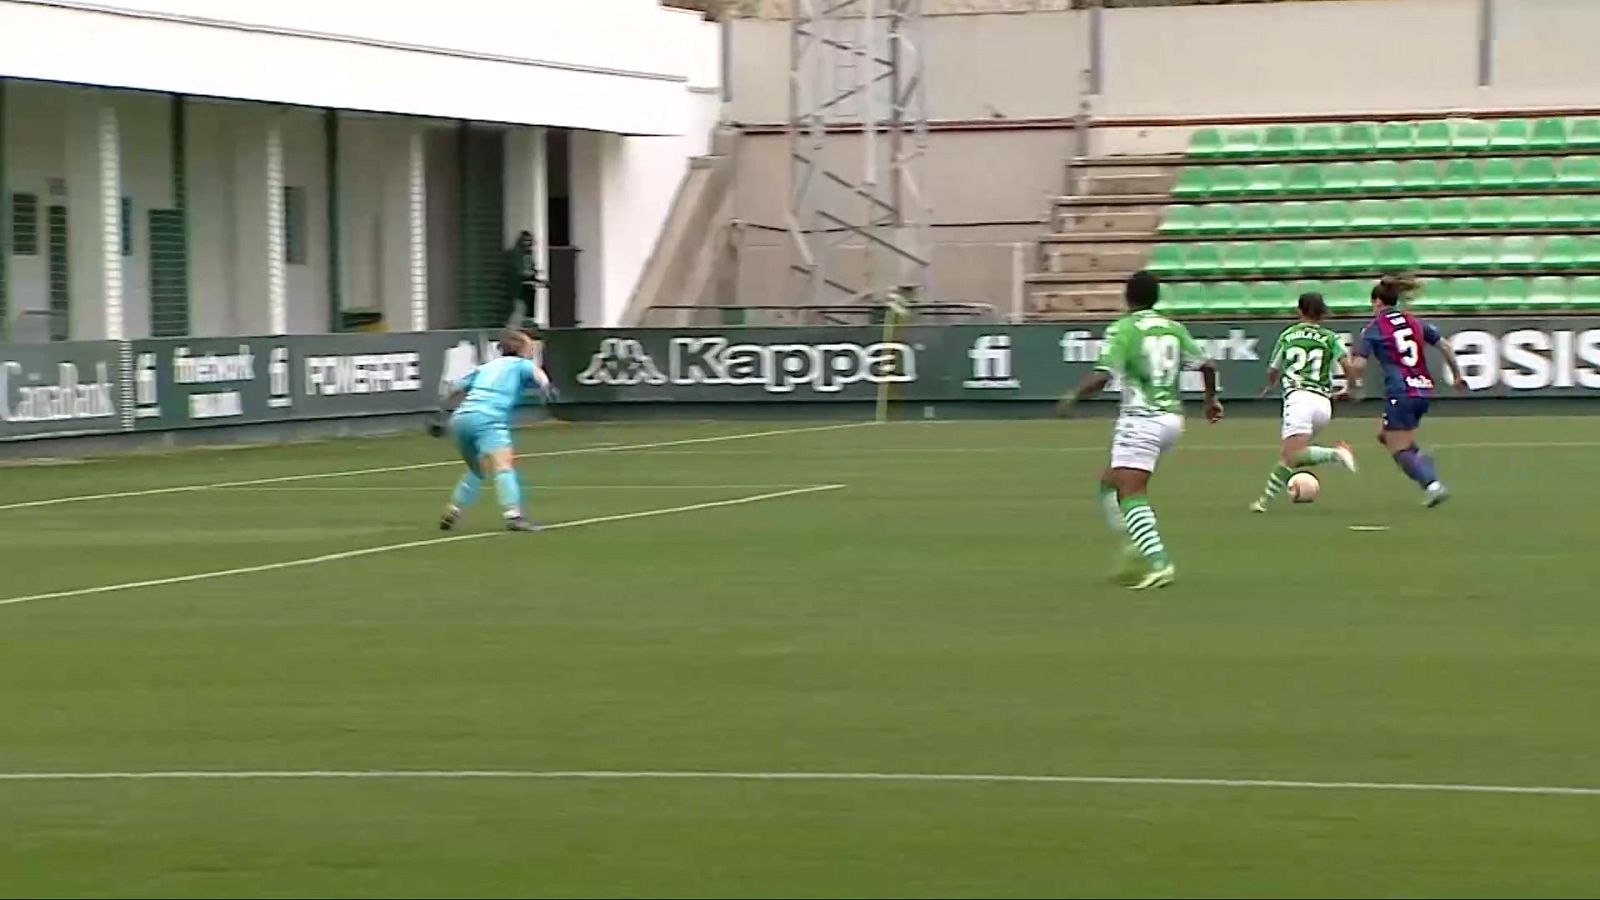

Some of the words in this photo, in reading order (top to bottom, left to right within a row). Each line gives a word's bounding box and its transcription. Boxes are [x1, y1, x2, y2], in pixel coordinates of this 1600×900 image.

[670, 337, 917, 392] Kappa
[1141, 335, 1181, 386] 19
[1285, 346, 1324, 381] 21
[1393, 327, 1419, 367] 5
